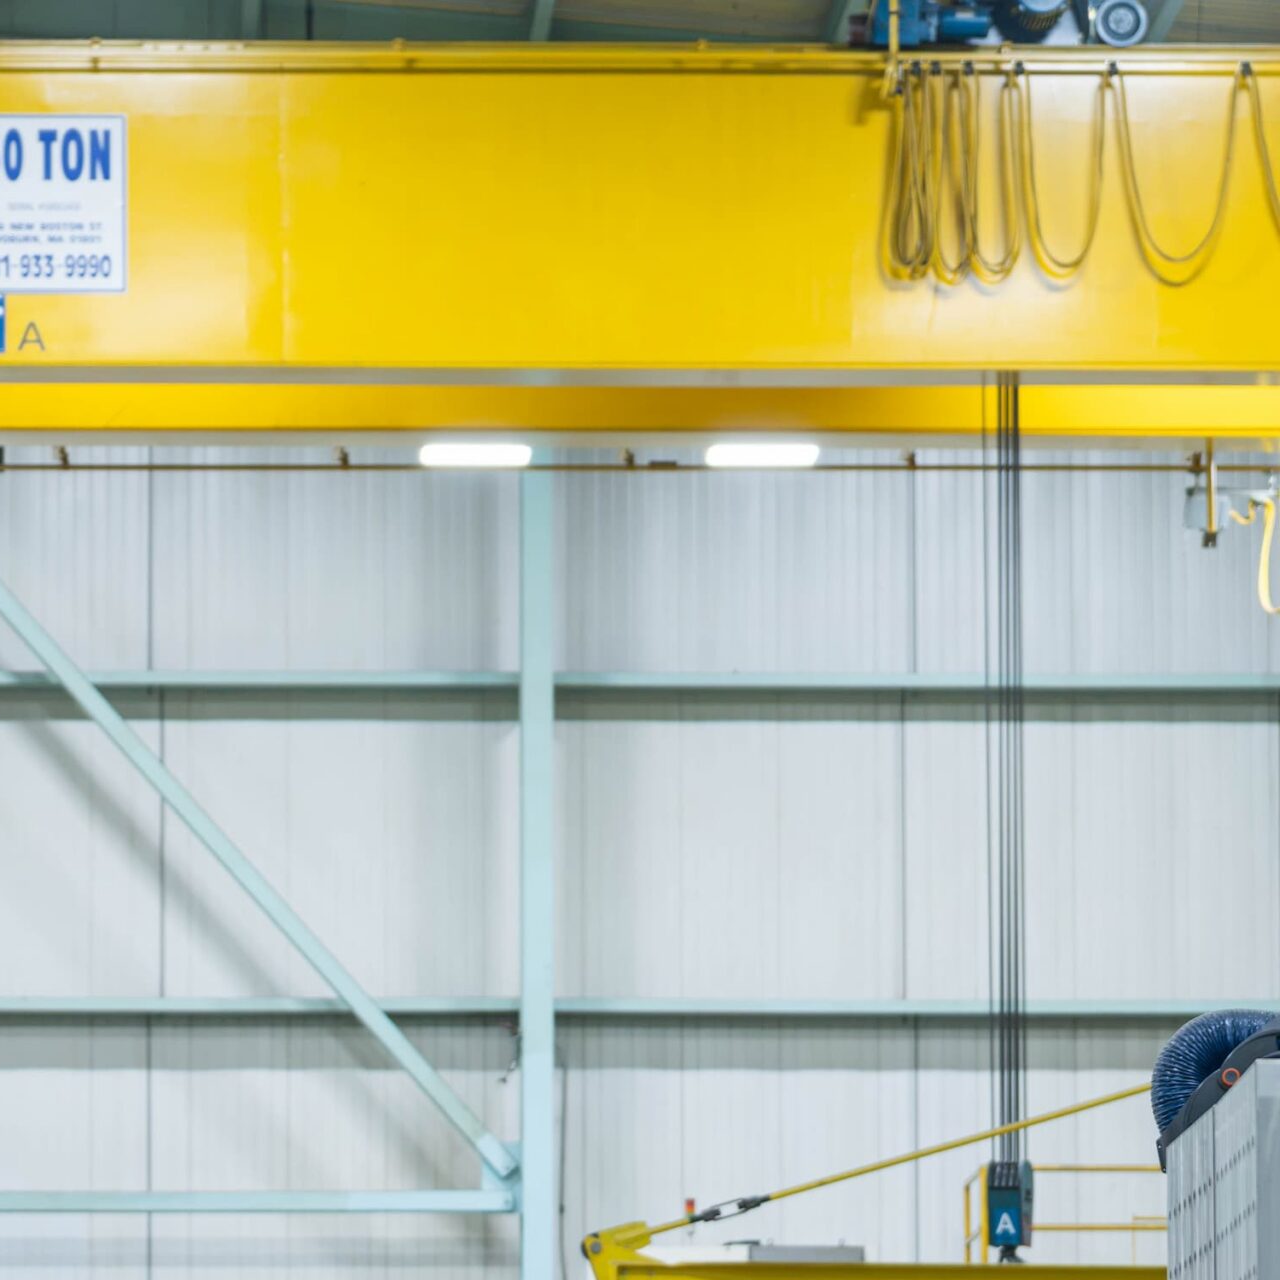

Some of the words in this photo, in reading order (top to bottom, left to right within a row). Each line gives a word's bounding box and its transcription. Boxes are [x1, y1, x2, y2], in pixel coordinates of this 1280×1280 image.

[38, 128, 112, 181] TON
[17, 321, 46, 351] A
[995, 1211, 1017, 1235] A
